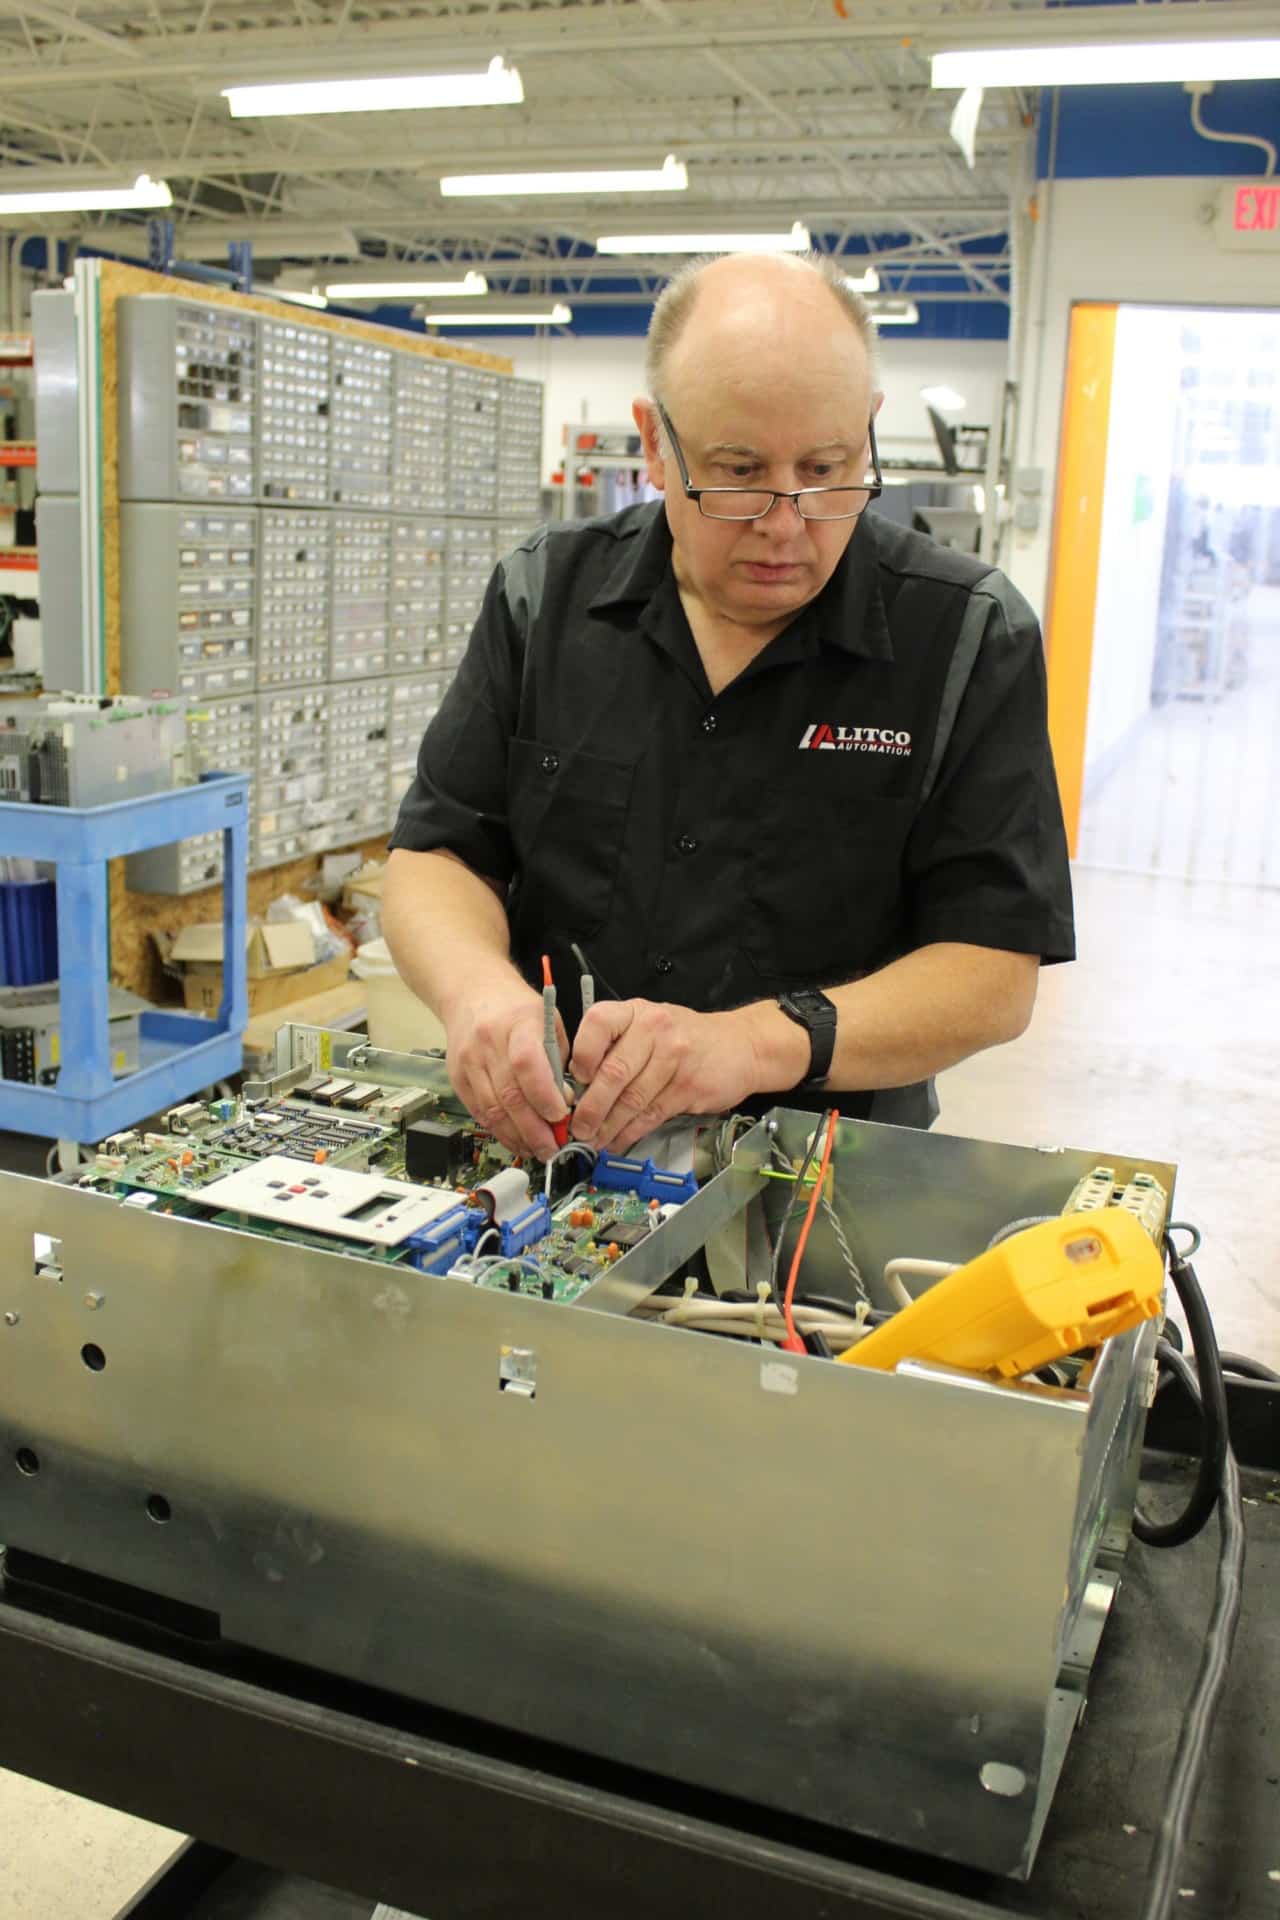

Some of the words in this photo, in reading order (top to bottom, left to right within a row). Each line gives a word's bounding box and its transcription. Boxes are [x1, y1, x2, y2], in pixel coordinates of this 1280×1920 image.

[1233, 185, 1280, 230] EXI
[836, 726, 911, 746] LITCO
[836, 742, 912, 756] AUTOMATION
